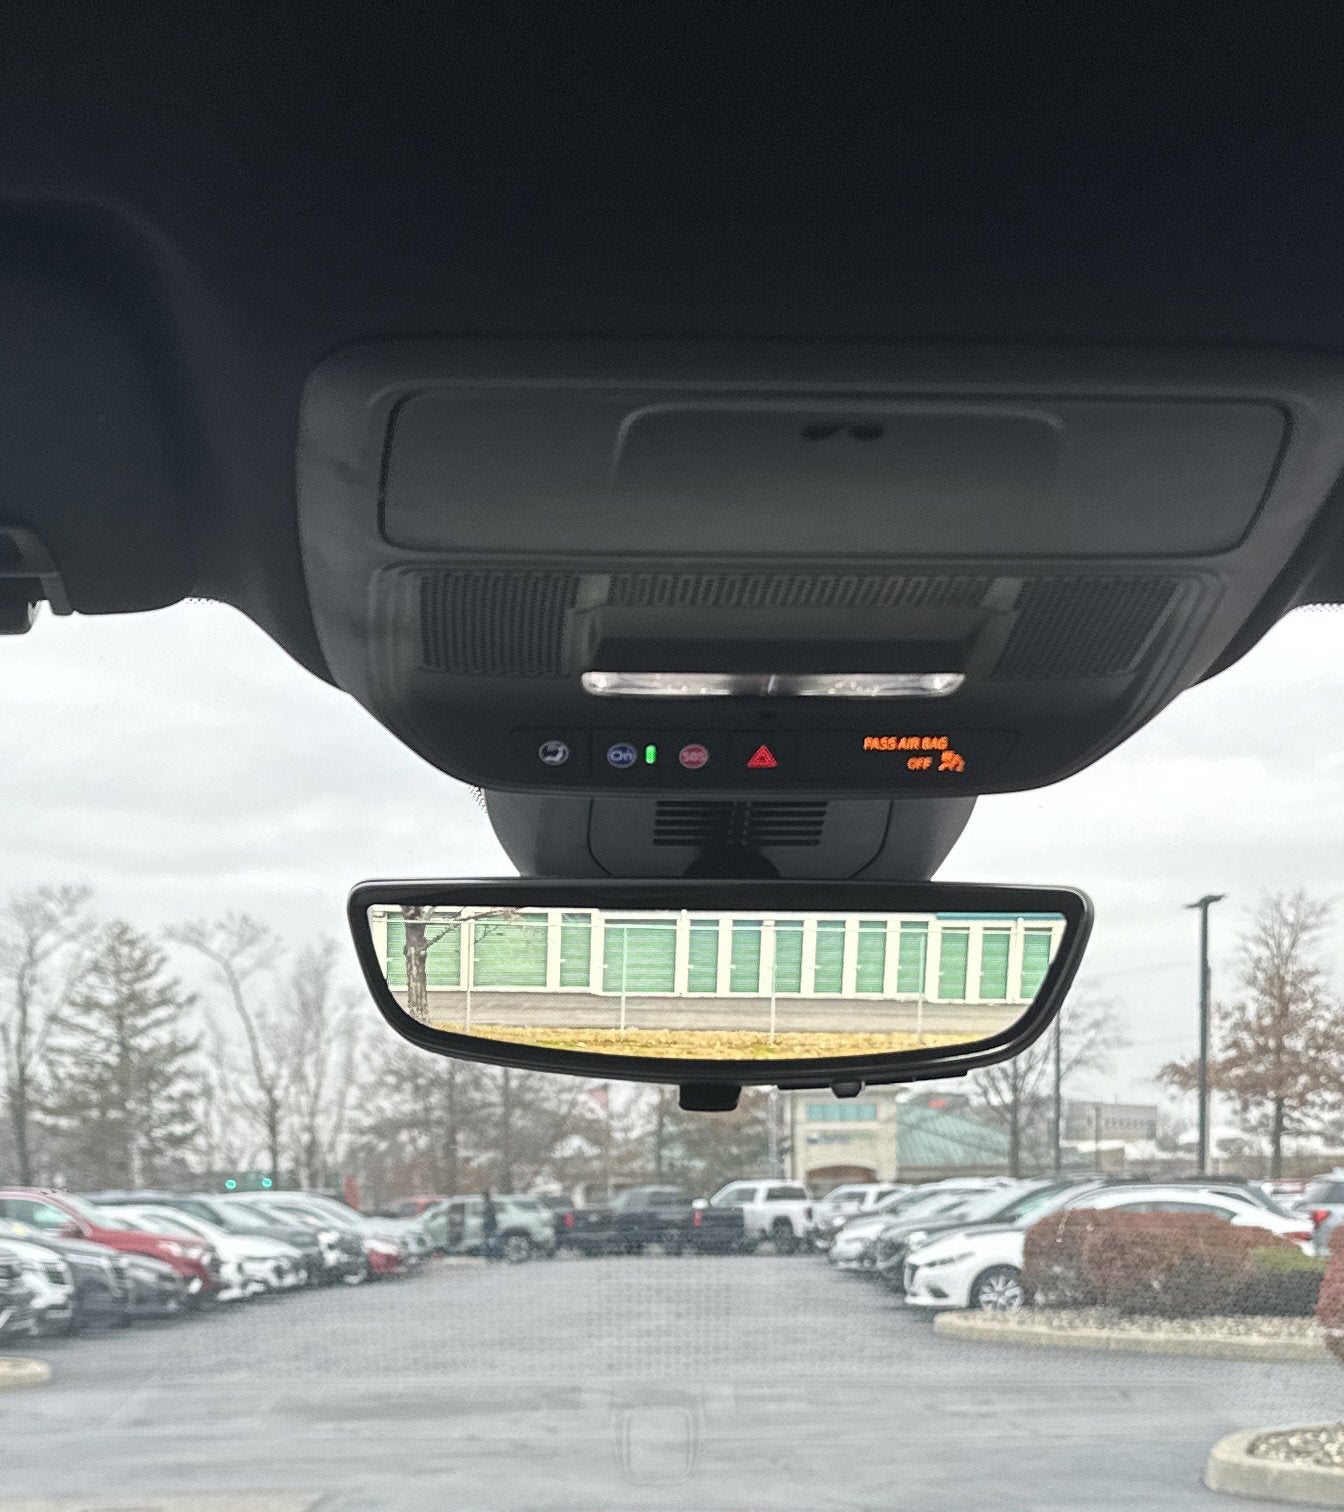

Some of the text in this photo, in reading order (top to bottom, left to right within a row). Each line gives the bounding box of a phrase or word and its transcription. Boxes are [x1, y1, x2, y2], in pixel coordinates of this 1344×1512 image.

[863, 736, 948, 751] PASS AIR BAG
[907, 756, 933, 770] OFF
